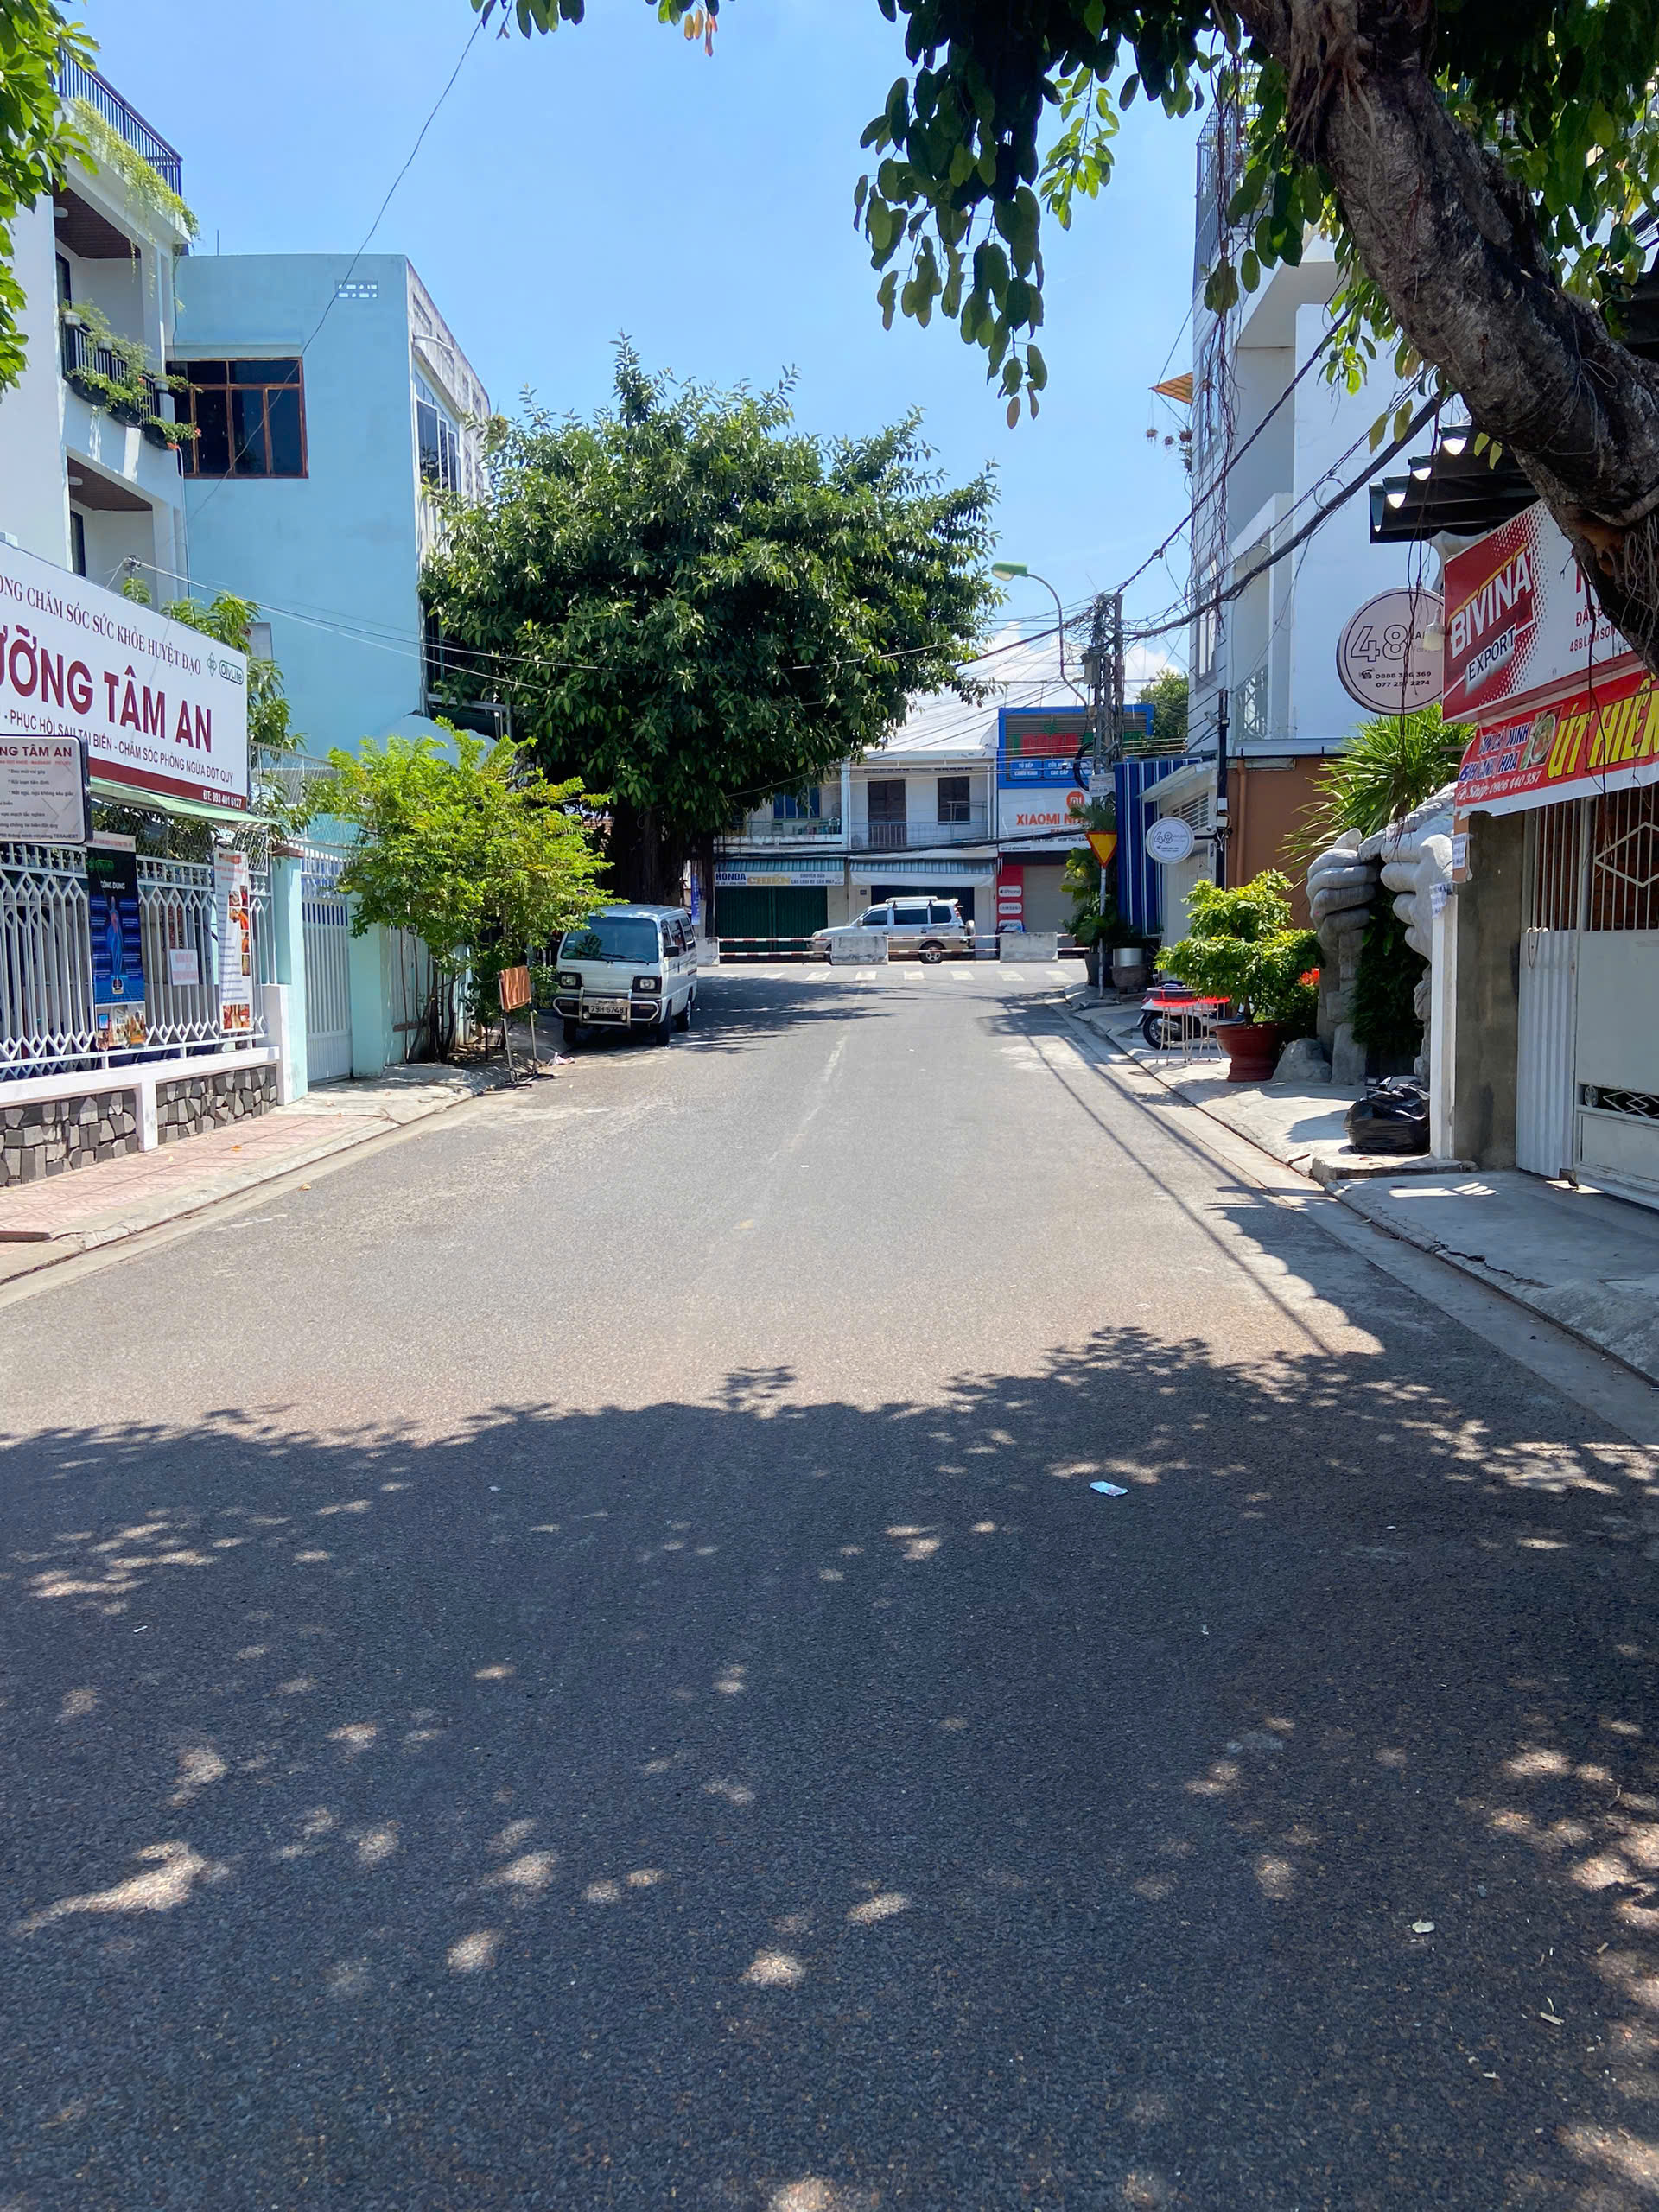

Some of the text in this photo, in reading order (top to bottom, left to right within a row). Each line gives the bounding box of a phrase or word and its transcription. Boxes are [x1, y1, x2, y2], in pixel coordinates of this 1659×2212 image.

[1450, 551, 1532, 660] BIVINA
[27, 587, 63, 619] CHĂM
[67, 602, 90, 629] SÓC
[92, 613, 114, 639] SỨC
[181, 653, 201, 676] ĐẠO
[1351, 624, 1408, 663] 48
[1569, 637, 1583, 652] 48B
[1468, 626, 1516, 681] EXPORT
[104, 665, 166, 740] TÂM
[175, 700, 212, 753] AN
[10, 709, 36, 733] PHỤC
[143, 747, 158, 763] SÓC
[160, 752, 184, 770] PHÒNG
[1504, 722, 1530, 748] NINH
[22, 743, 49, 757] TÂM
[54, 747, 73, 757] AN
[1524, 771, 1542, 785] 387
[212, 792, 221, 804] 093
[231, 797, 242, 809] 6127
[1016, 813, 1061, 825] XIAOMI
[1154, 831, 1173, 844] 48
